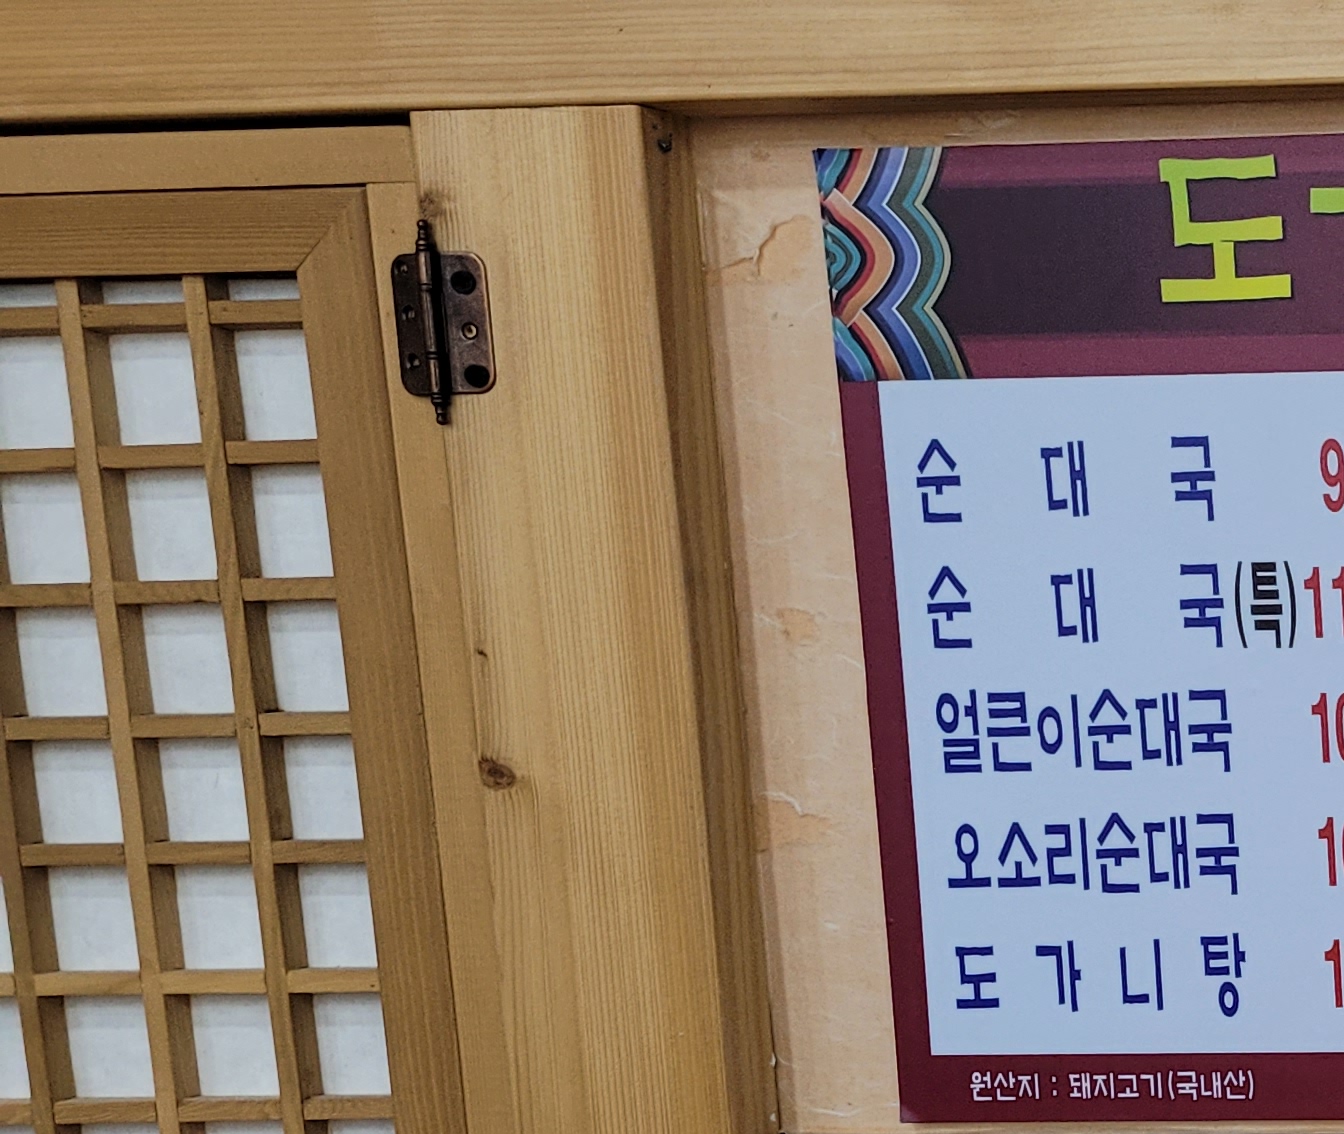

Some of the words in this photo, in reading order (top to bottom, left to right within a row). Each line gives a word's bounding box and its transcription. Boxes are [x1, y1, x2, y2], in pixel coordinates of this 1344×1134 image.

[936, 689, 1232, 773] 얼큰이순대국
[948, 812, 1239, 895] 오소리순대국
[970, 1072, 1040, 1101] 원산지
[1069, 1070, 1254, 1101] 돼지고기(국내산)
